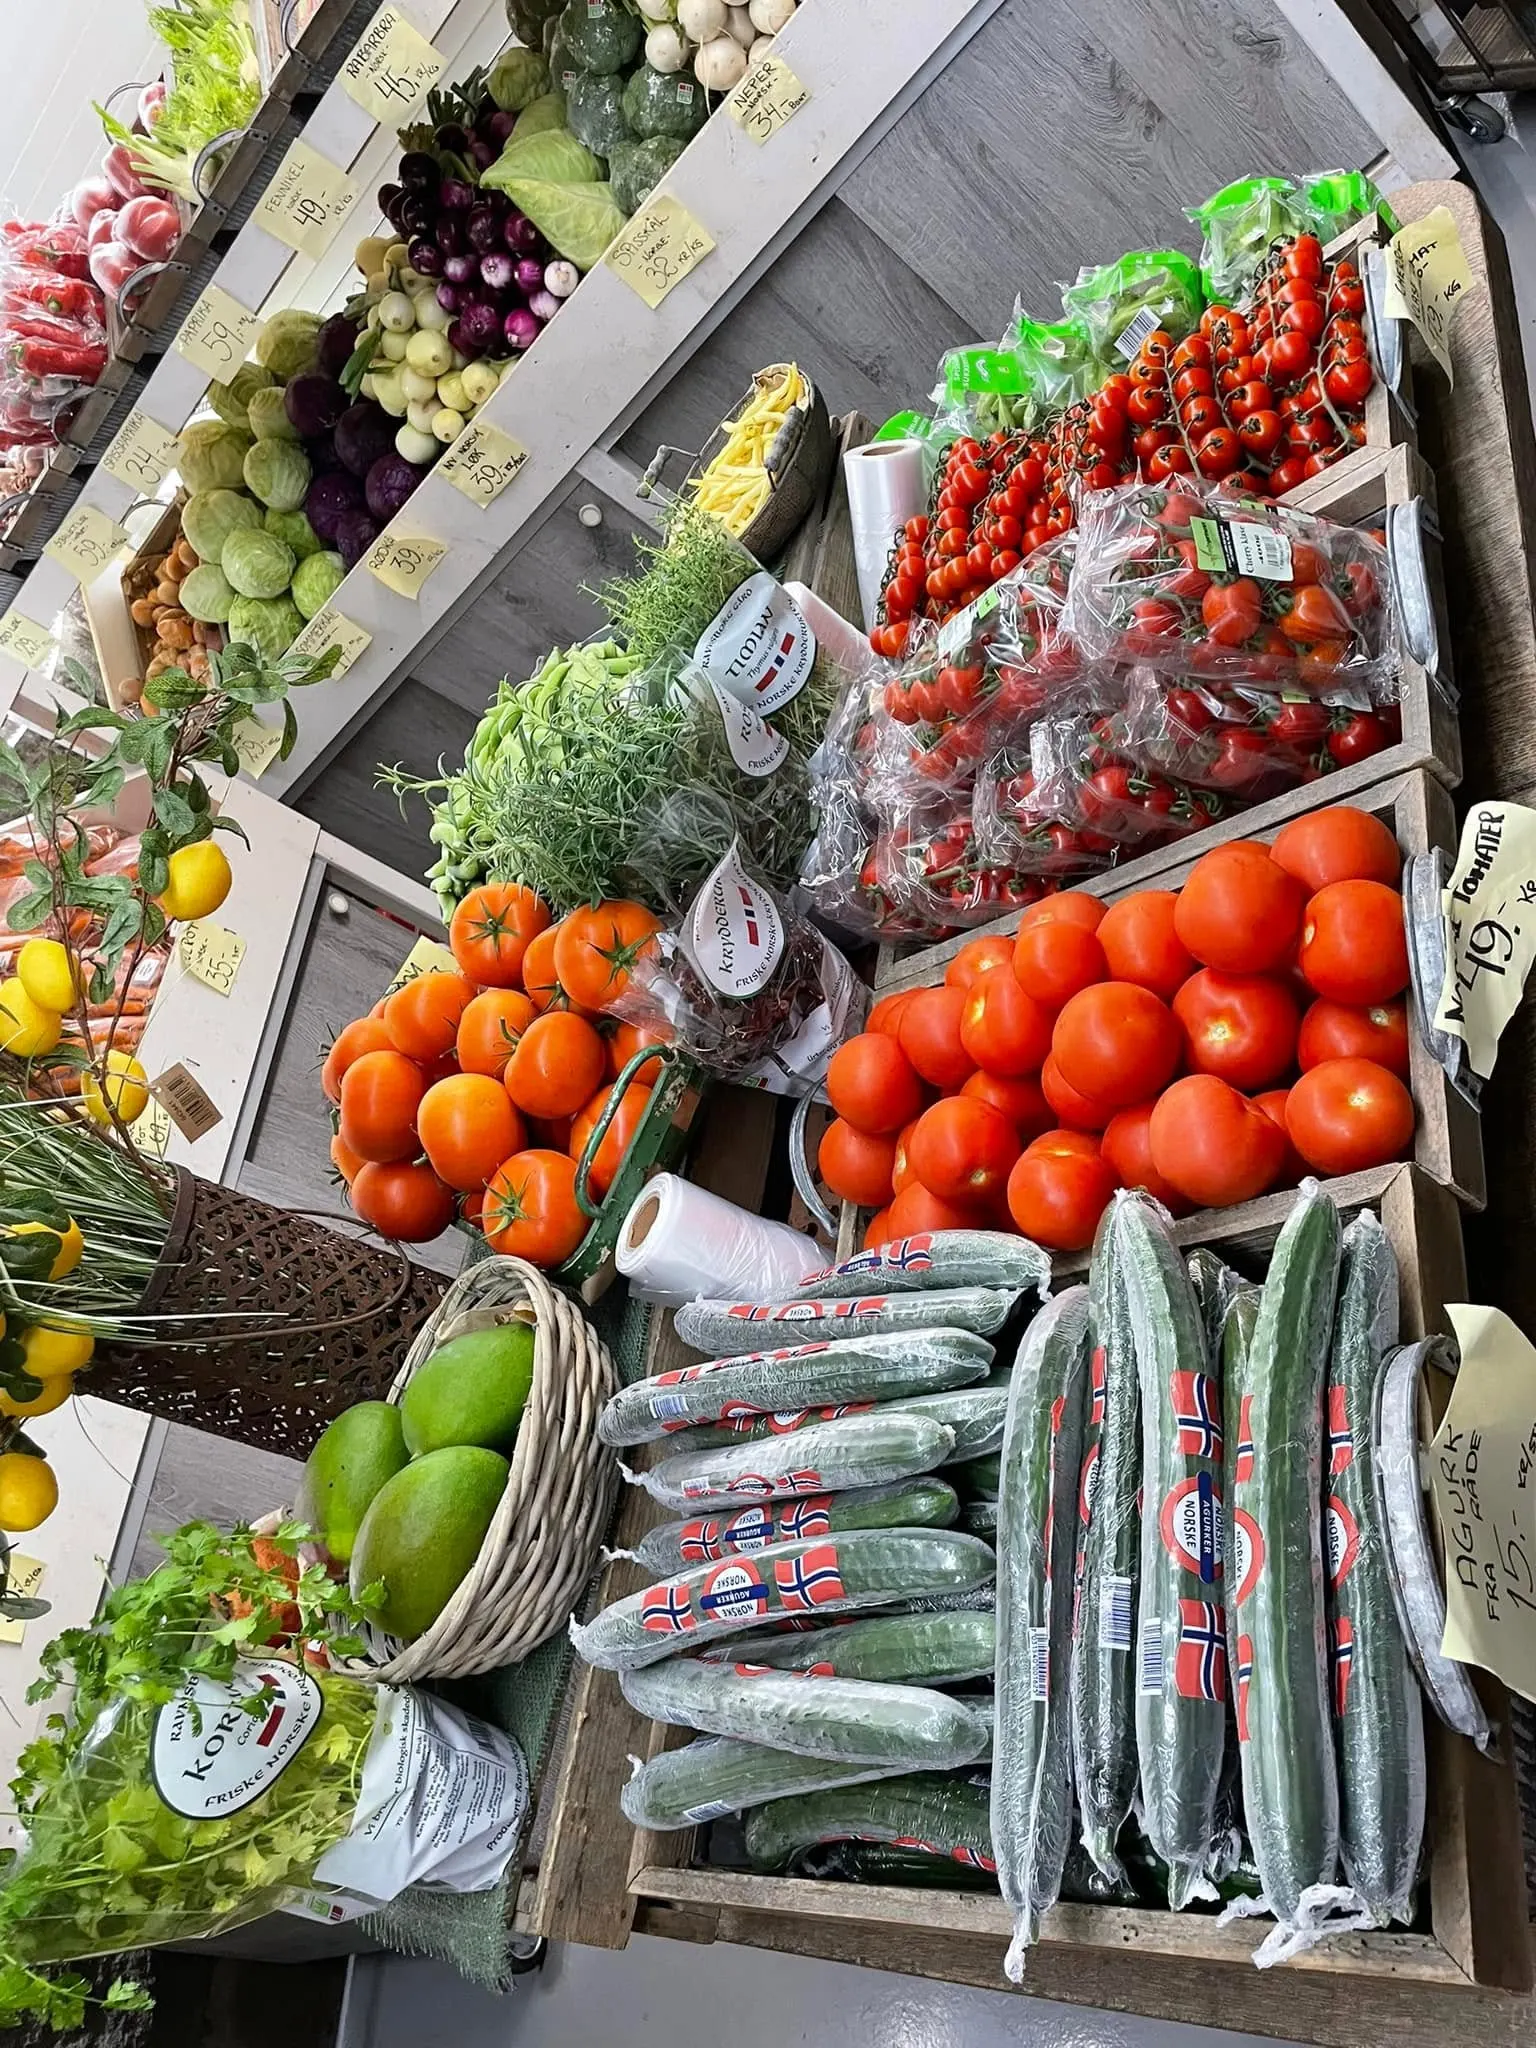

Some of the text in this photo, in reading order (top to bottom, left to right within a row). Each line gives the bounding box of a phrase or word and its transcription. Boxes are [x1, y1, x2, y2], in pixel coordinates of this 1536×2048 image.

[346, 13, 397, 79] RABARBRA
[734, 62, 777, 108] NEPER
[264, 161, 305, 213] FENNIKEL
[179, 300, 213, 346] PAPRIKA
[443, 457, 458, 471] NY
[757, 674, 797, 709] NORSKE
[1453, 811, 1505, 905] TOMATER
[735, 961, 768, 990] FRISKE
[1184, 1499, 1198, 1550] NORSKE
[1202, 1499, 1214, 1555] AGURKER
[1443, 1423, 1478, 1590] AGURK
[1329, 1516, 1340, 1568] NORSKE
[716, 1574, 747, 1590] NORSKE
[1483, 1562, 1501, 1622] FRA
[721, 1602, 754, 1618] NORSKE
[204, 1768, 266, 1809] FRISKE
[265, 1701, 312, 1770] NORSKE
[394, 1735, 408, 1786] biologisk
